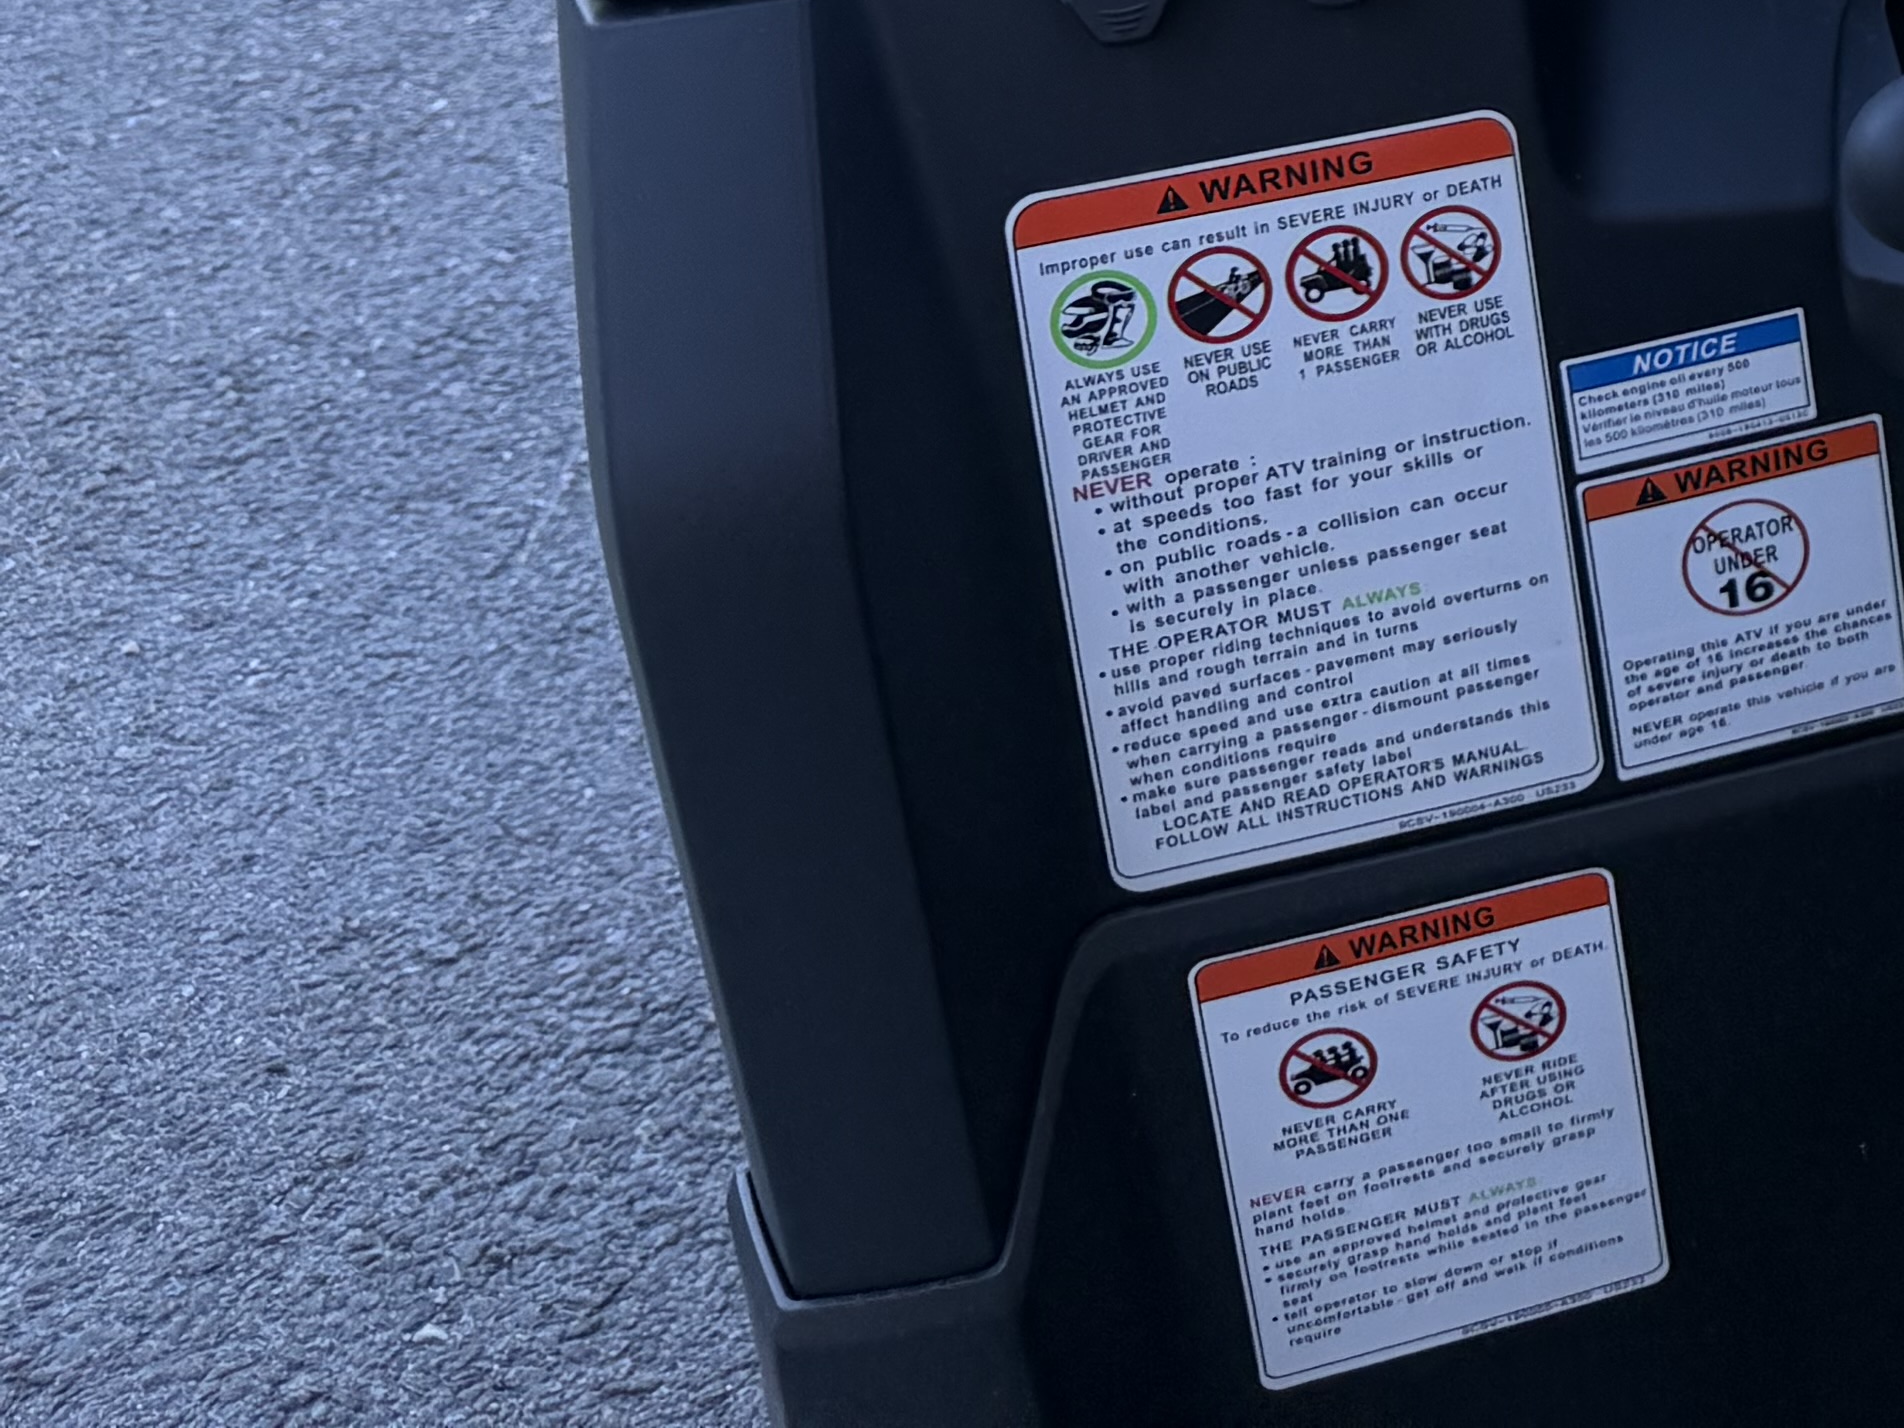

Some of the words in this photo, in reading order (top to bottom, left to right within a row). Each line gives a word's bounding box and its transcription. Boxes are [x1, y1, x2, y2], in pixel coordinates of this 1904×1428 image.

[1197, 150, 1373, 204] WARNING
[1038, 250, 1117, 277] Improper
[1122, 244, 1154, 260] use
[1160, 236, 1192, 253] can
[1197, 224, 1248, 251] result
[1252, 220, 1270, 235] in
[1276, 203, 1346, 231] SEVERE
[1351, 190, 1414, 217] INJURY
[1421, 188, 1440, 203] or
[1444, 173, 1503, 198] DEATH
[1291, 327, 1340, 348] NEVER
[1348, 315, 1396, 337] CARRY
[1413, 321, 1453, 341] WITH
[1457, 309, 1511, 333] DRUGS
[1416, 301, 1468, 325] NEVER
[1472, 294, 1504, 313] USE
[1182, 346, 1235, 370] NEVER
[1240, 338, 1272, 358] USE
[1302, 342, 1345, 363] MORE
[1351, 333, 1391, 353] THAN
[1314, 348, 1401, 377] PASSENGER
[1414, 340, 1438, 357] OR
[1443, 325, 1515, 352] ALCOHOL
[1631, 331, 1738, 375] NOTICE
[1186, 367, 1211, 385] ON
[1215, 354, 1272, 379] PUBLIC
[1204, 373, 1259, 397] ROADS
[1071, 470, 1153, 503] NEVER
[1163, 458, 1240, 485] operate
[1108, 481, 1185, 513] without
[1193, 470, 1259, 500] proper
[1264, 458, 1305, 482] ATV
[1310, 444, 1387, 472] training
[1393, 438, 1415, 454] or
[1421, 415, 1531, 448] instruction.
[1673, 438, 1829, 494] WARNING
[1691, 513, 1794, 555] OPERATOR
[1713, 543, 1779, 575] UNDER
[1718, 567, 1775, 612] 16
[1107, 638, 1150, 661] THE
[1156, 613, 1269, 650] OPERATOR
[1276, 599, 1332, 625] MUST
[1341, 581, 1421, 611] ALWAYS
[1154, 821, 1229, 851] FOLLOW
[1235, 813, 1270, 833] ALL
[1275, 782, 1404, 824] INSTRUCTIONS
[1410, 773, 1447, 793] AND
[1452, 750, 1544, 783] WARNINGS
[1161, 803, 1233, 832] LOCATE
[1238, 794, 1276, 815] AND
[1282, 782, 1331, 805] READ
[1347, 905, 1495, 960] WARNING
[1288, 960, 1427, 1007] PASSENGER
[1435, 936, 1520, 971] SAFETY
